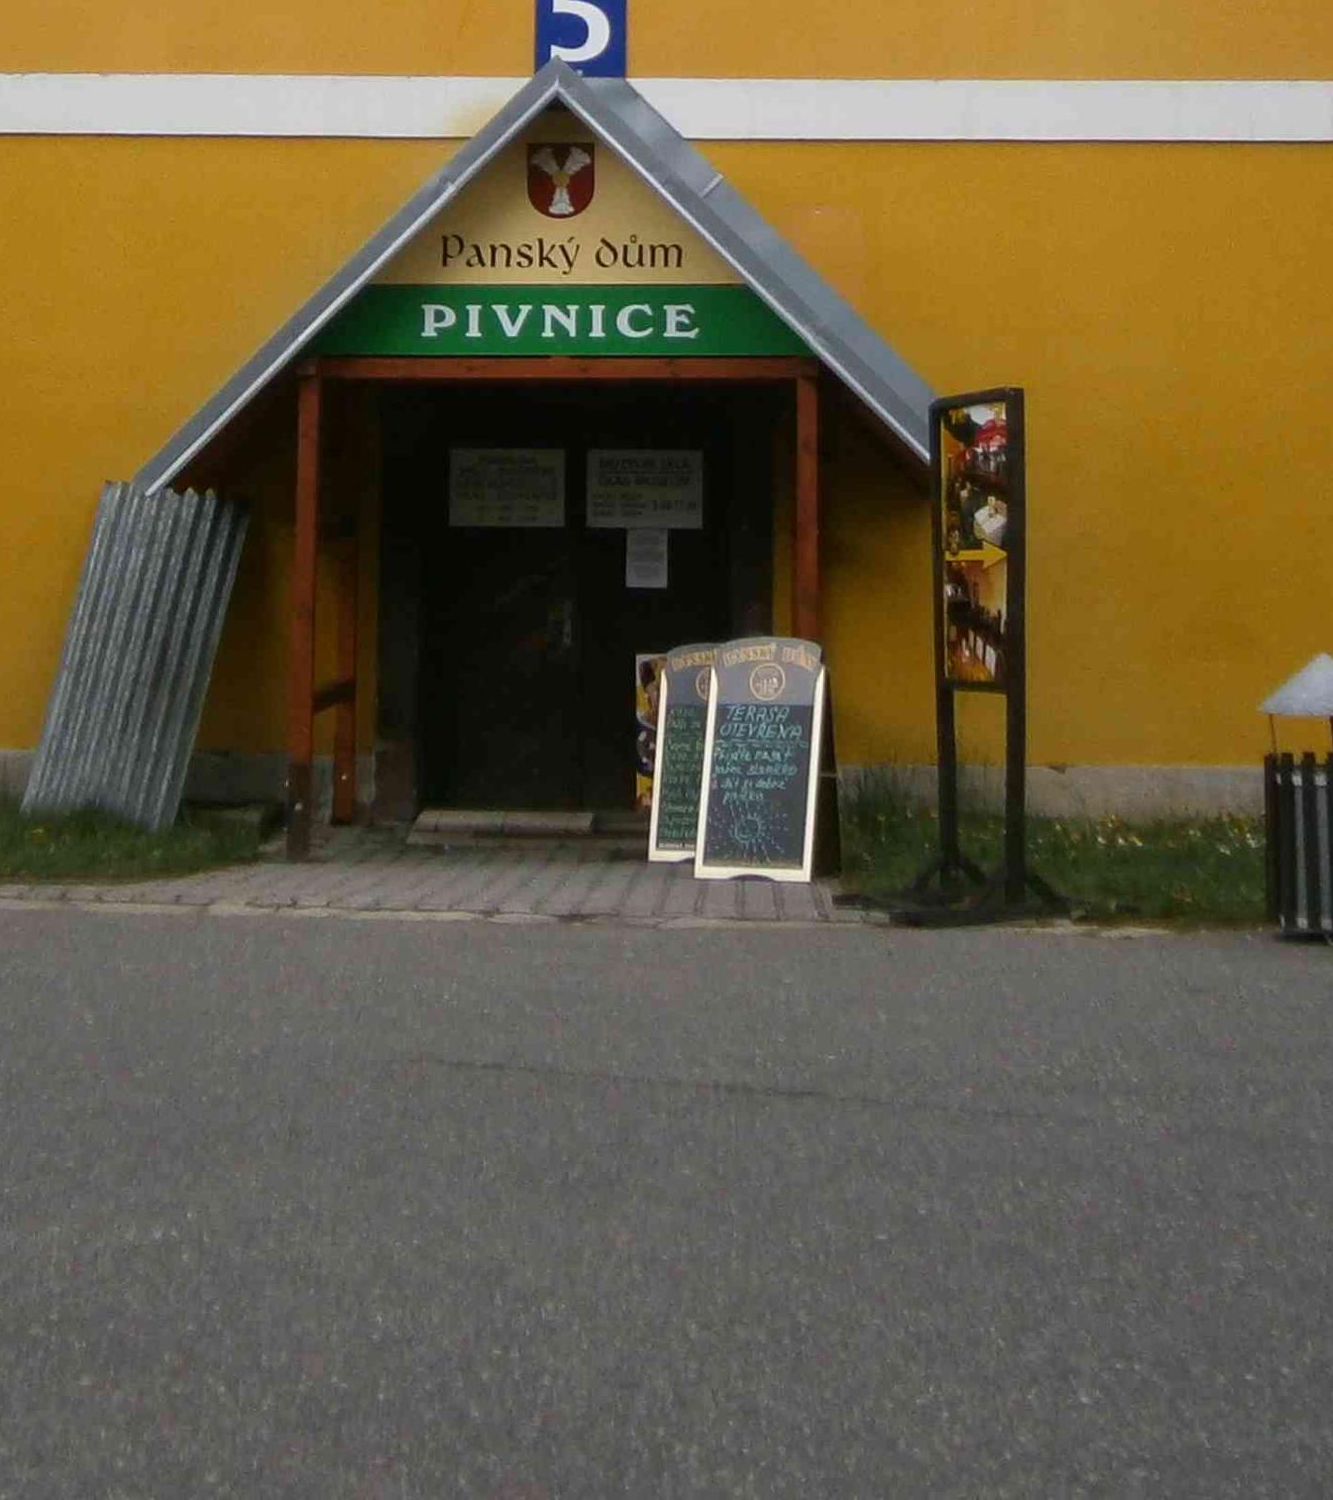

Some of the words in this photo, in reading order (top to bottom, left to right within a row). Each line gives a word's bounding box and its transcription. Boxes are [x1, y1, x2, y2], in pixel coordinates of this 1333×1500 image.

[440, 233, 581, 276] Panský
[594, 233, 684, 269] dům
[420, 303, 700, 339] PIVNICE
[726, 704, 790, 724] TERASA
